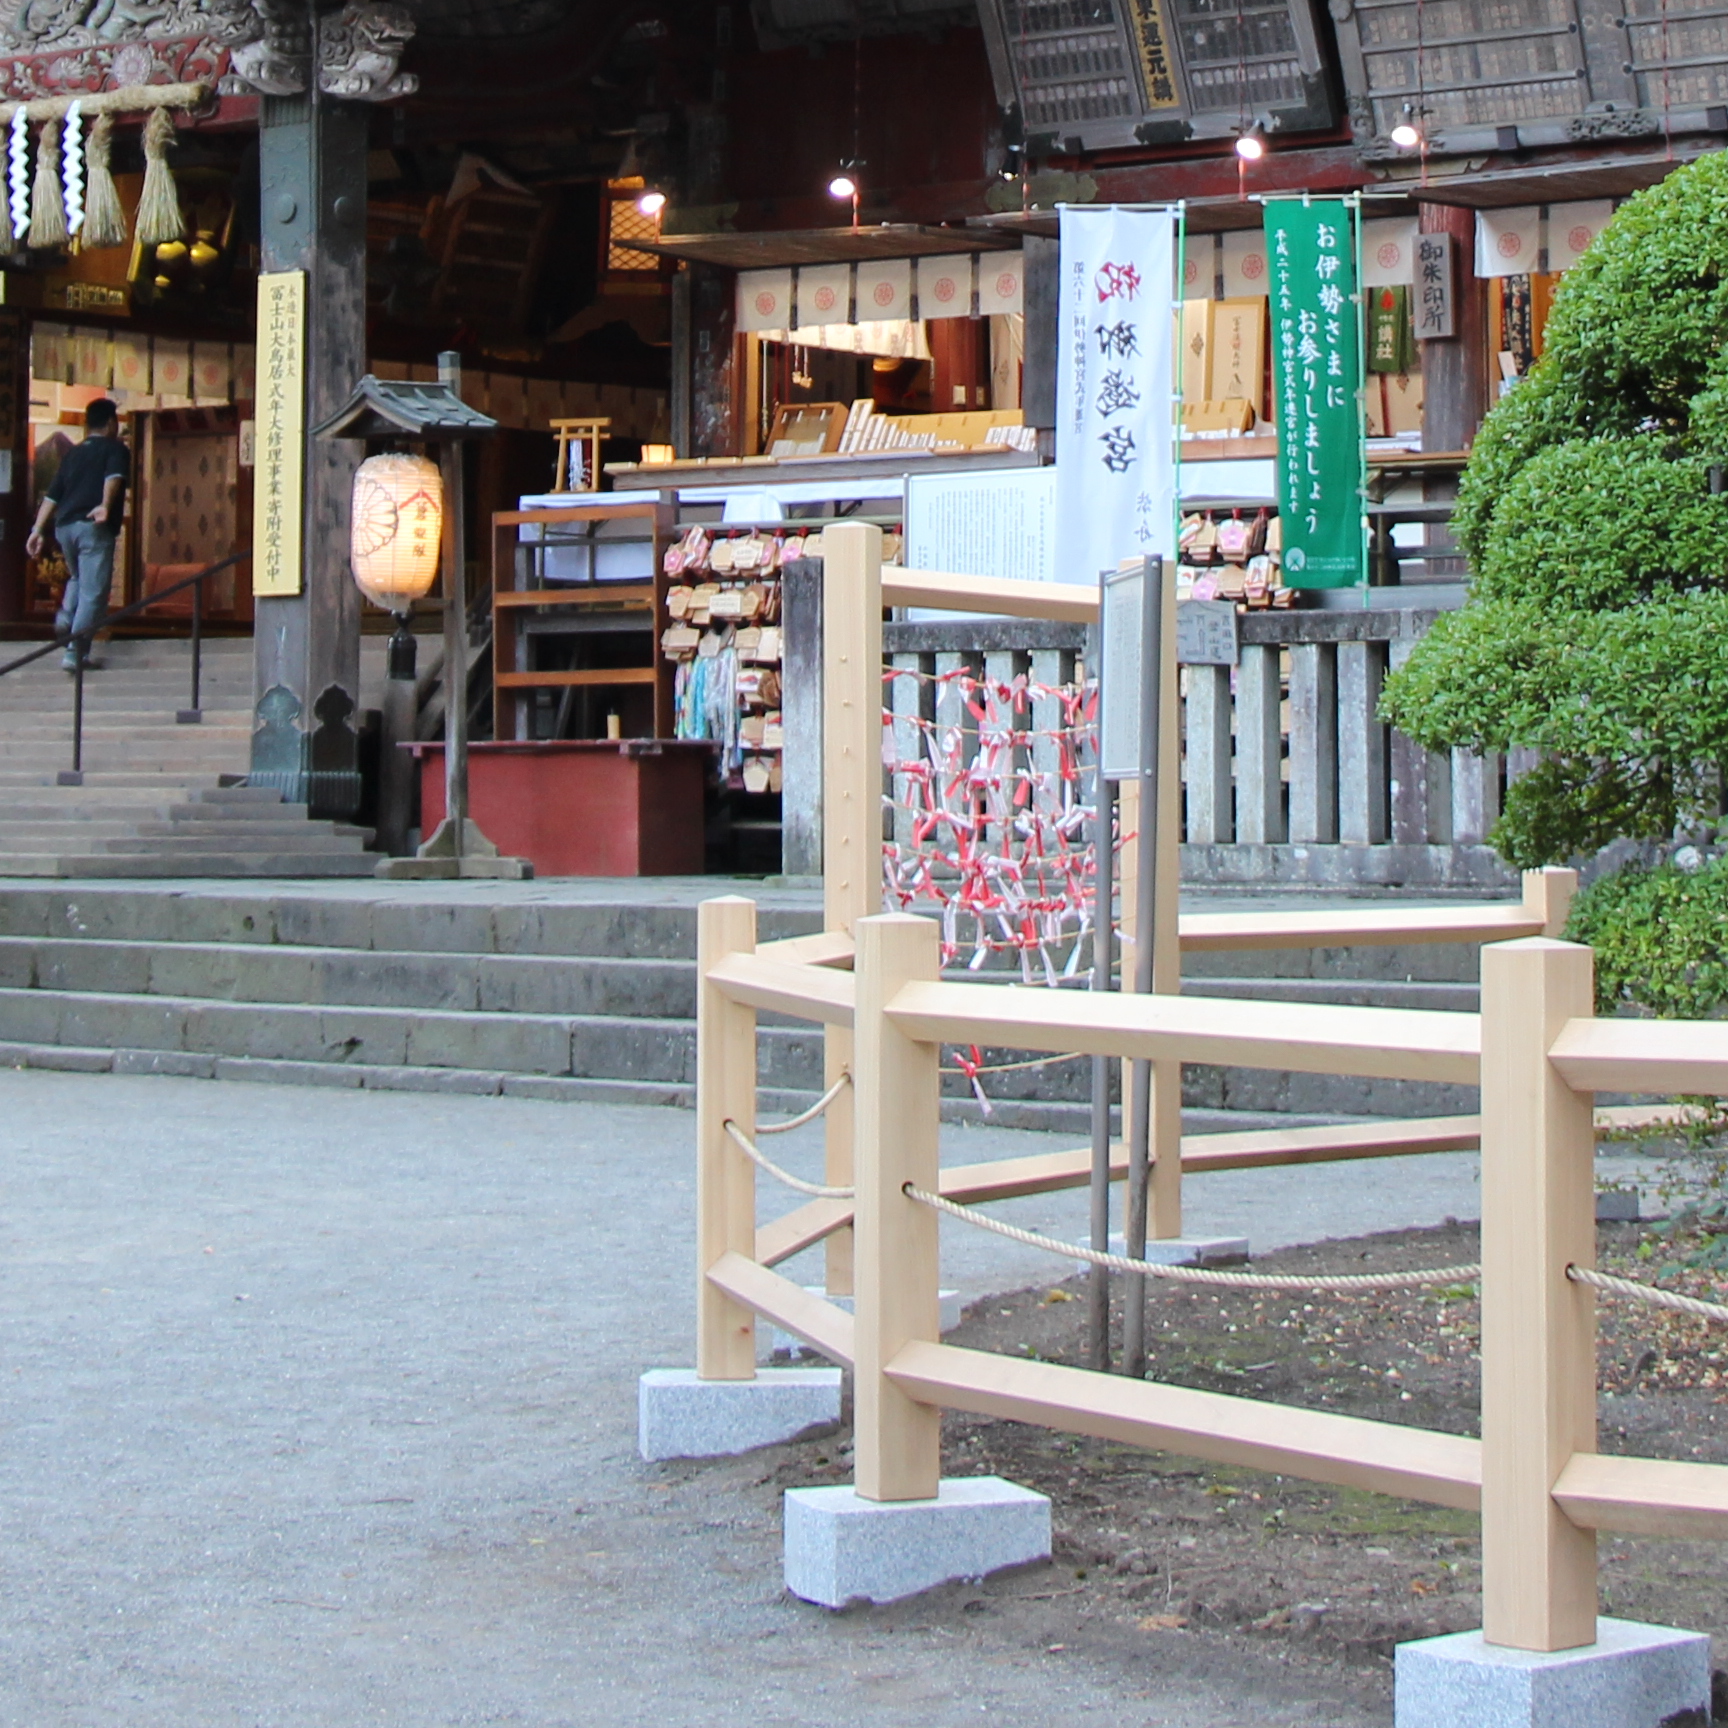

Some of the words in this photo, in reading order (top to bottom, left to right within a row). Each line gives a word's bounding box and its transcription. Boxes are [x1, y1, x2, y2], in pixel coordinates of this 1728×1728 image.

[1315, 223, 1346, 408] お伊勢さまに
[1419, 239, 1444, 332] 御朱印所
[1297, 308, 1322, 535] お参りしましょう
